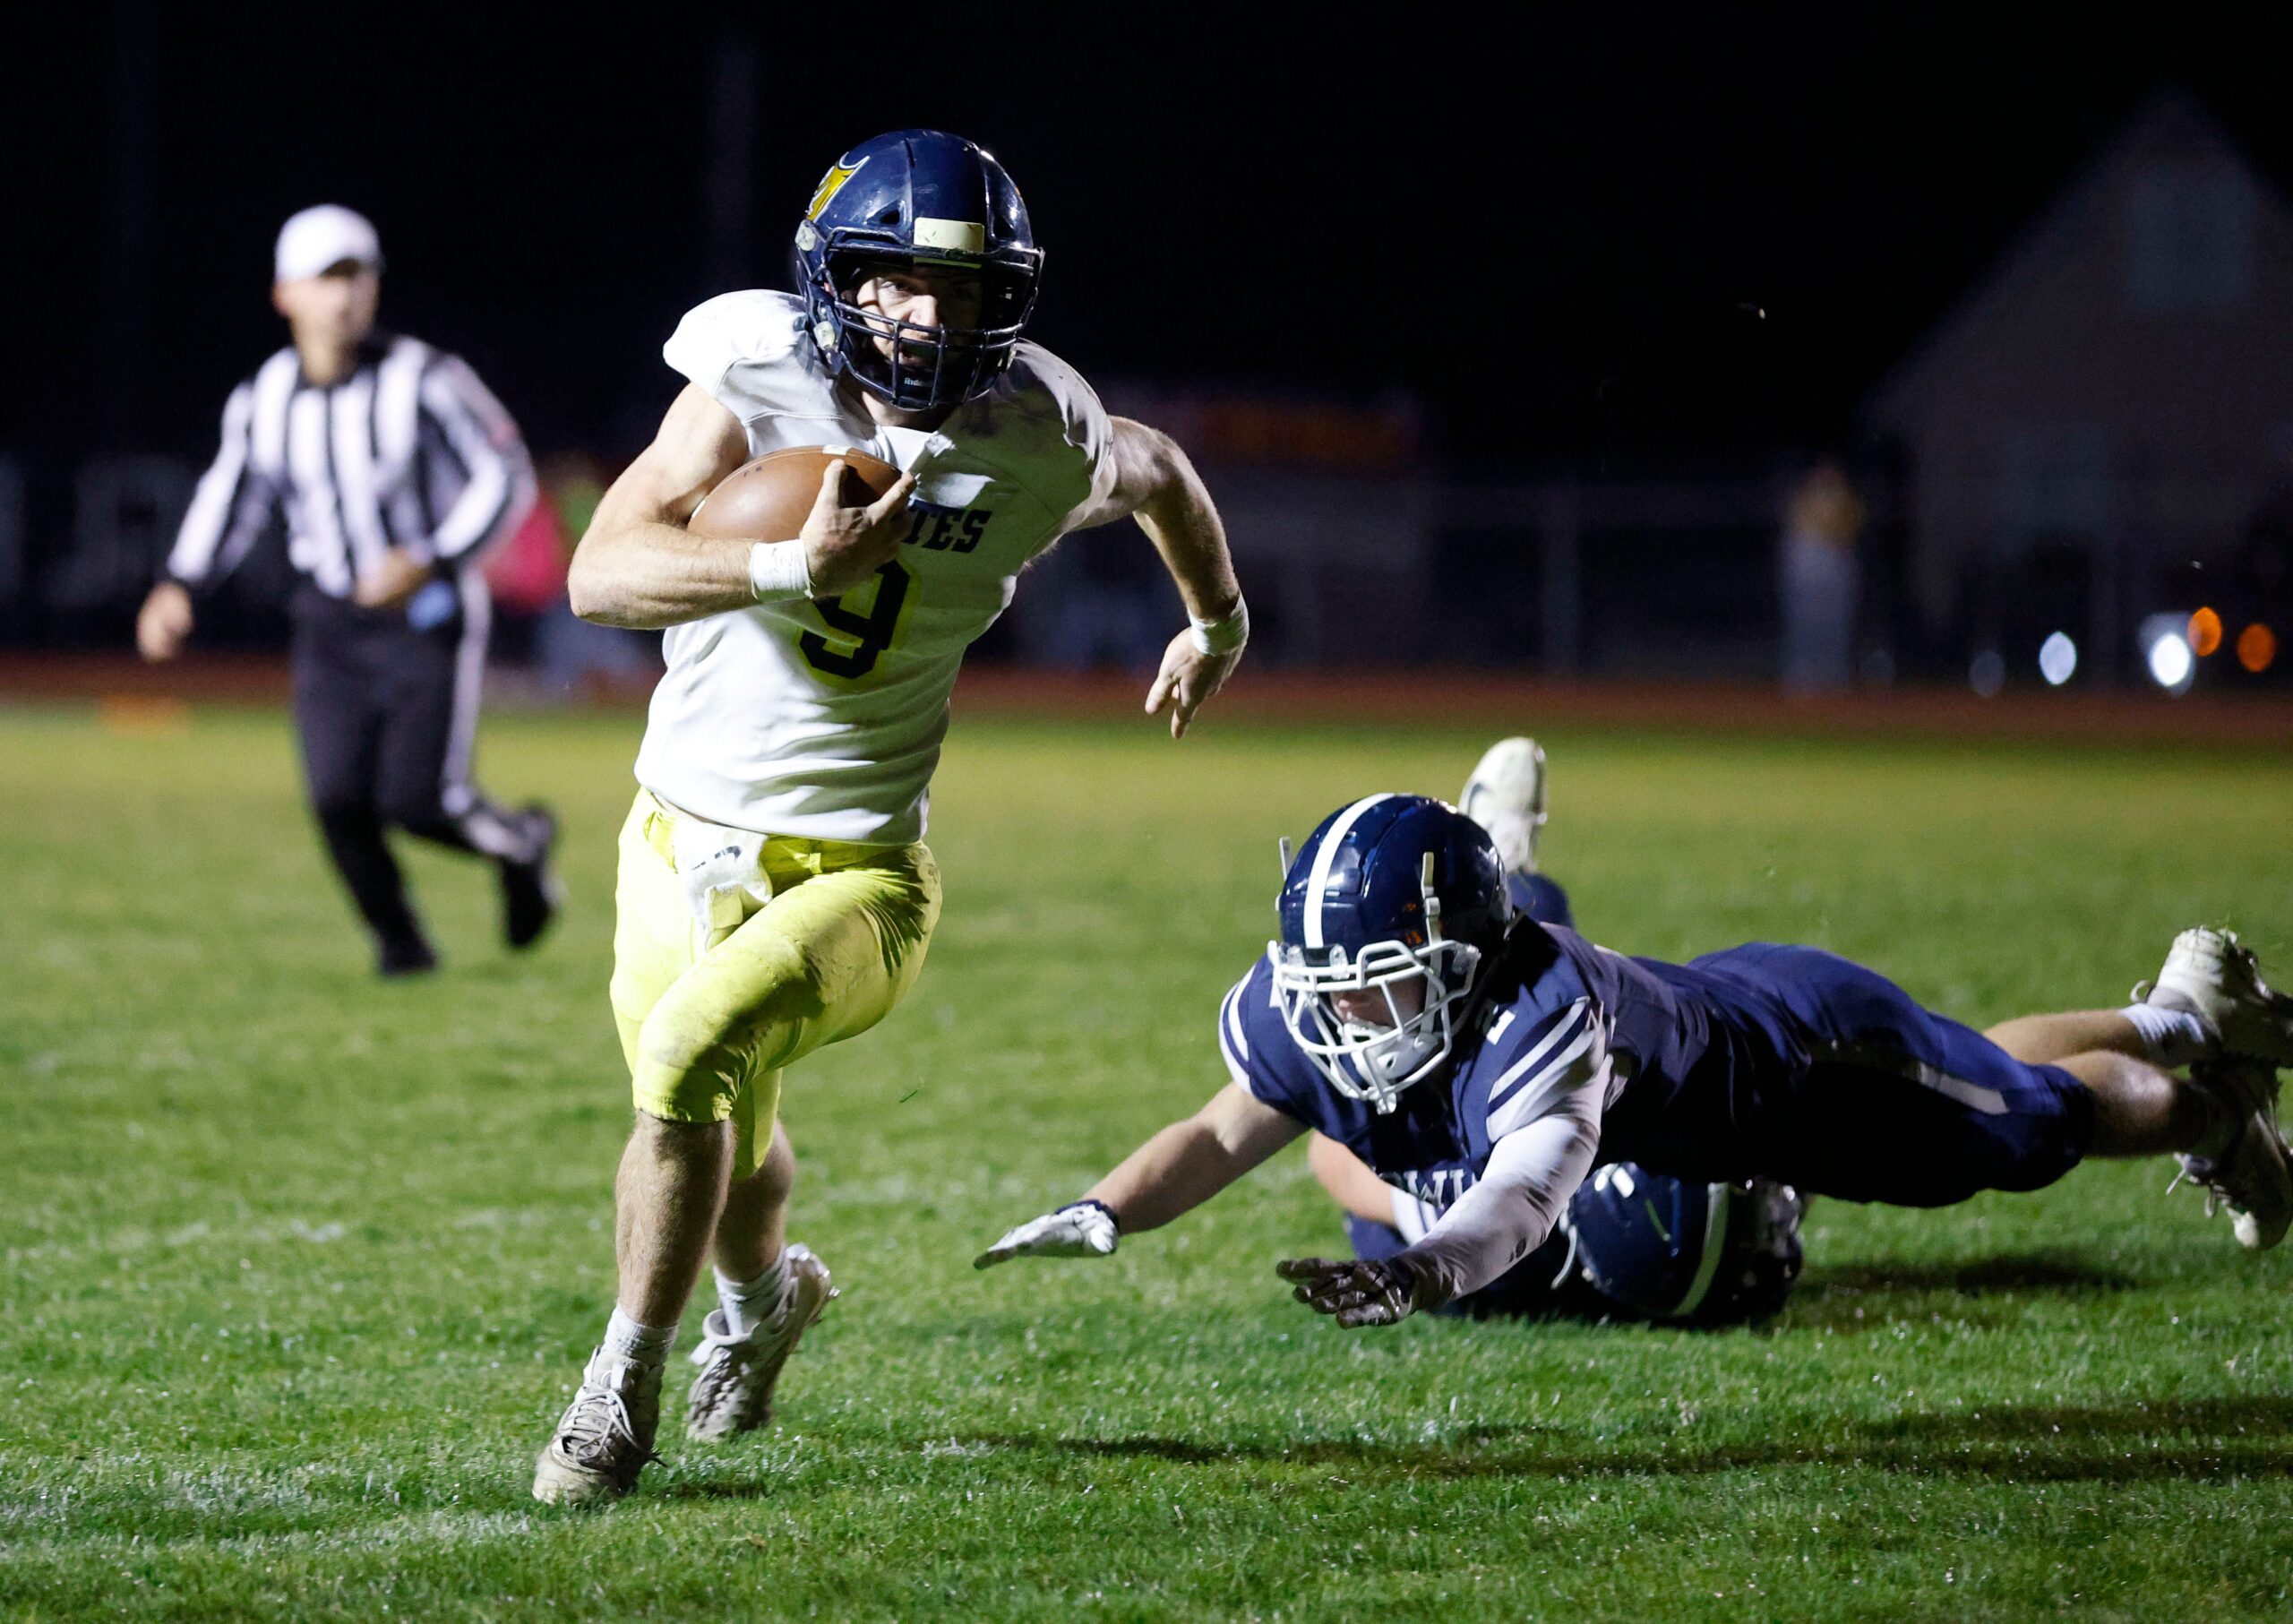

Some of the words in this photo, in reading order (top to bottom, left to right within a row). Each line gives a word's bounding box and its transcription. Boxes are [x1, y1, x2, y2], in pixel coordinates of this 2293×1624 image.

[901, 499, 992, 554] TES
[798, 558, 911, 681] 9
[1379, 1168, 1480, 1210] WI
